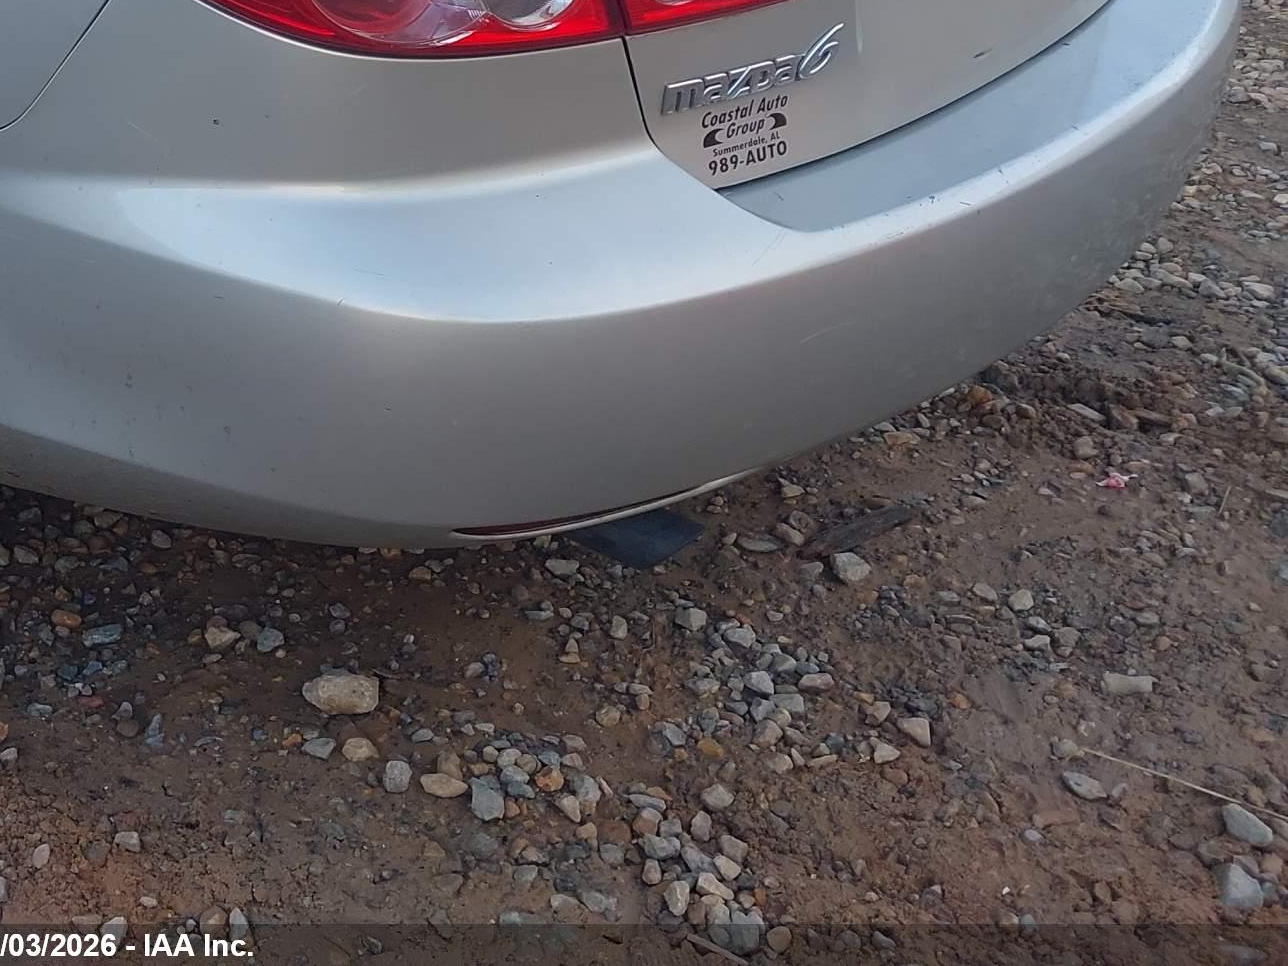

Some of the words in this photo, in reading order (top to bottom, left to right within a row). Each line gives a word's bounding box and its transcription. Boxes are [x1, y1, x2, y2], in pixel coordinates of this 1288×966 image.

[701, 99, 754, 129] Coastal
[756, 94, 788, 115] Auto
[725, 117, 766, 140] Group
[708, 140, 788, 176] 989-AUTO
[712, 137, 768, 158] Summerdale,
[769, 131, 781, 142] AL
